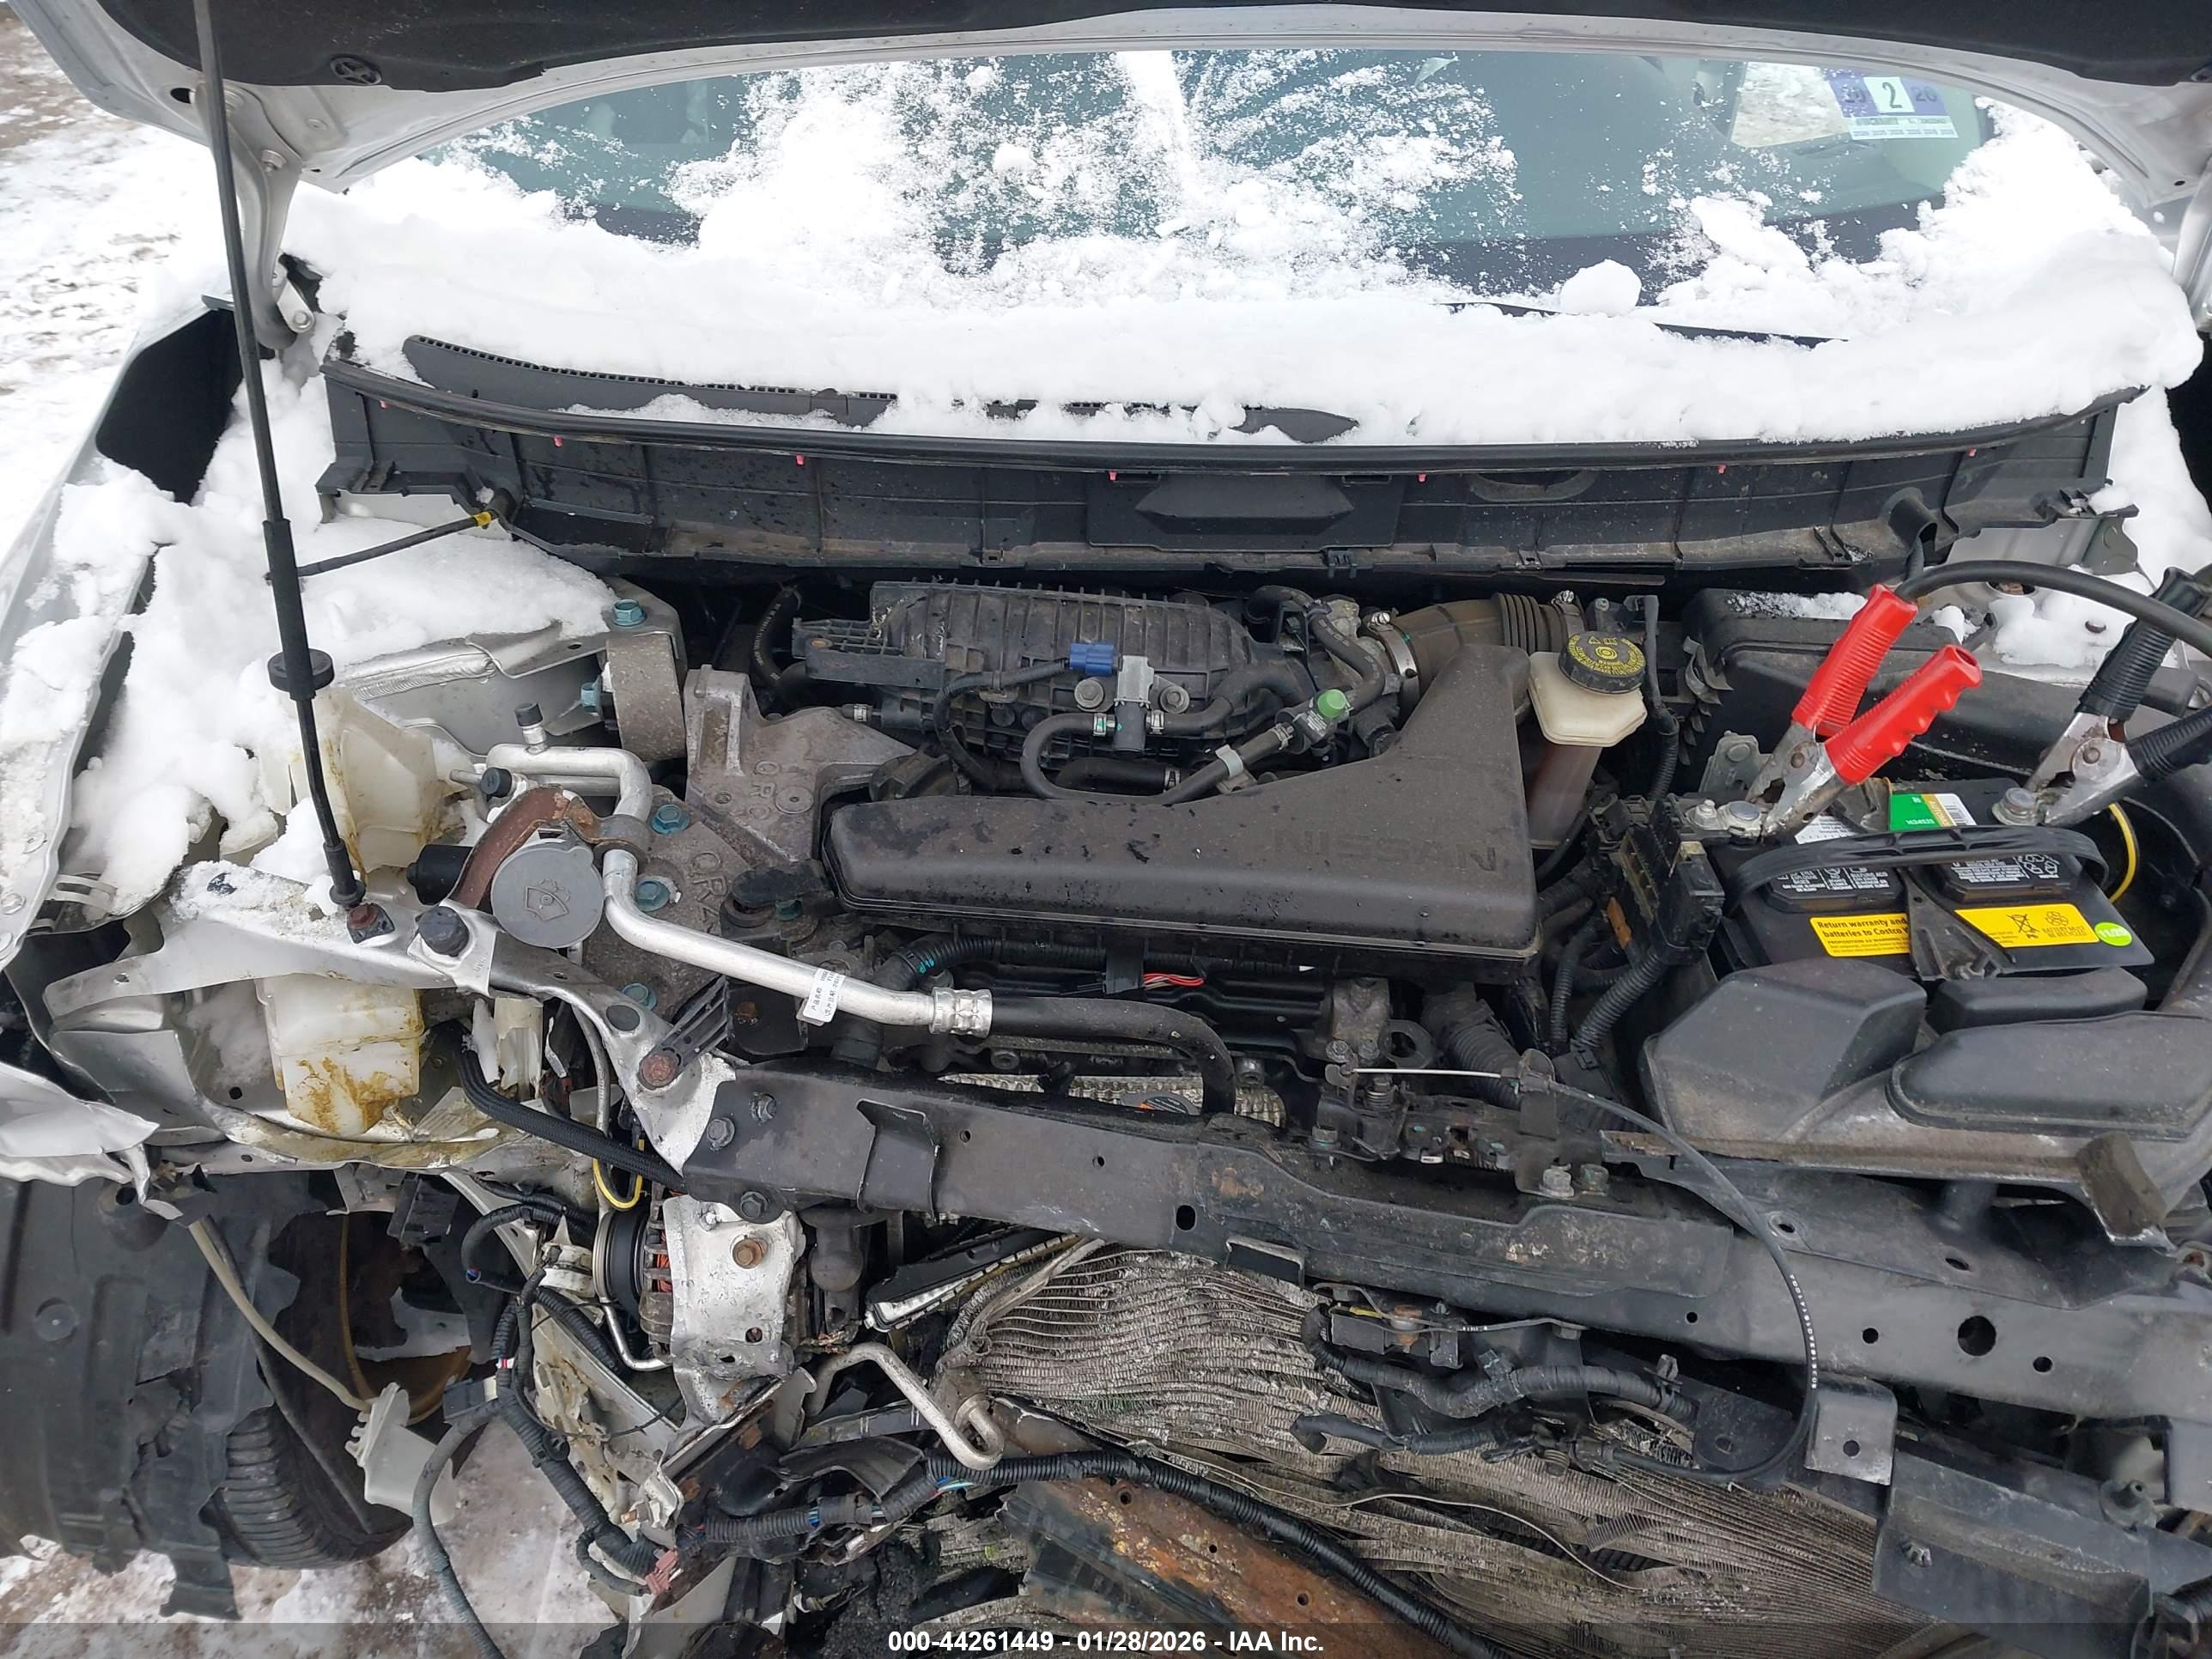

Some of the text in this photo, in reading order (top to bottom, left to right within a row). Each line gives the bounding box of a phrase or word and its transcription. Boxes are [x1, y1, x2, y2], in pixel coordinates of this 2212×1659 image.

[1881, 82, 1903, 109] 2
[1817, 916, 1907, 929] Return warranty and
[1822, 929, 1863, 938] batteries
[1874, 927, 1902, 935] Costco
